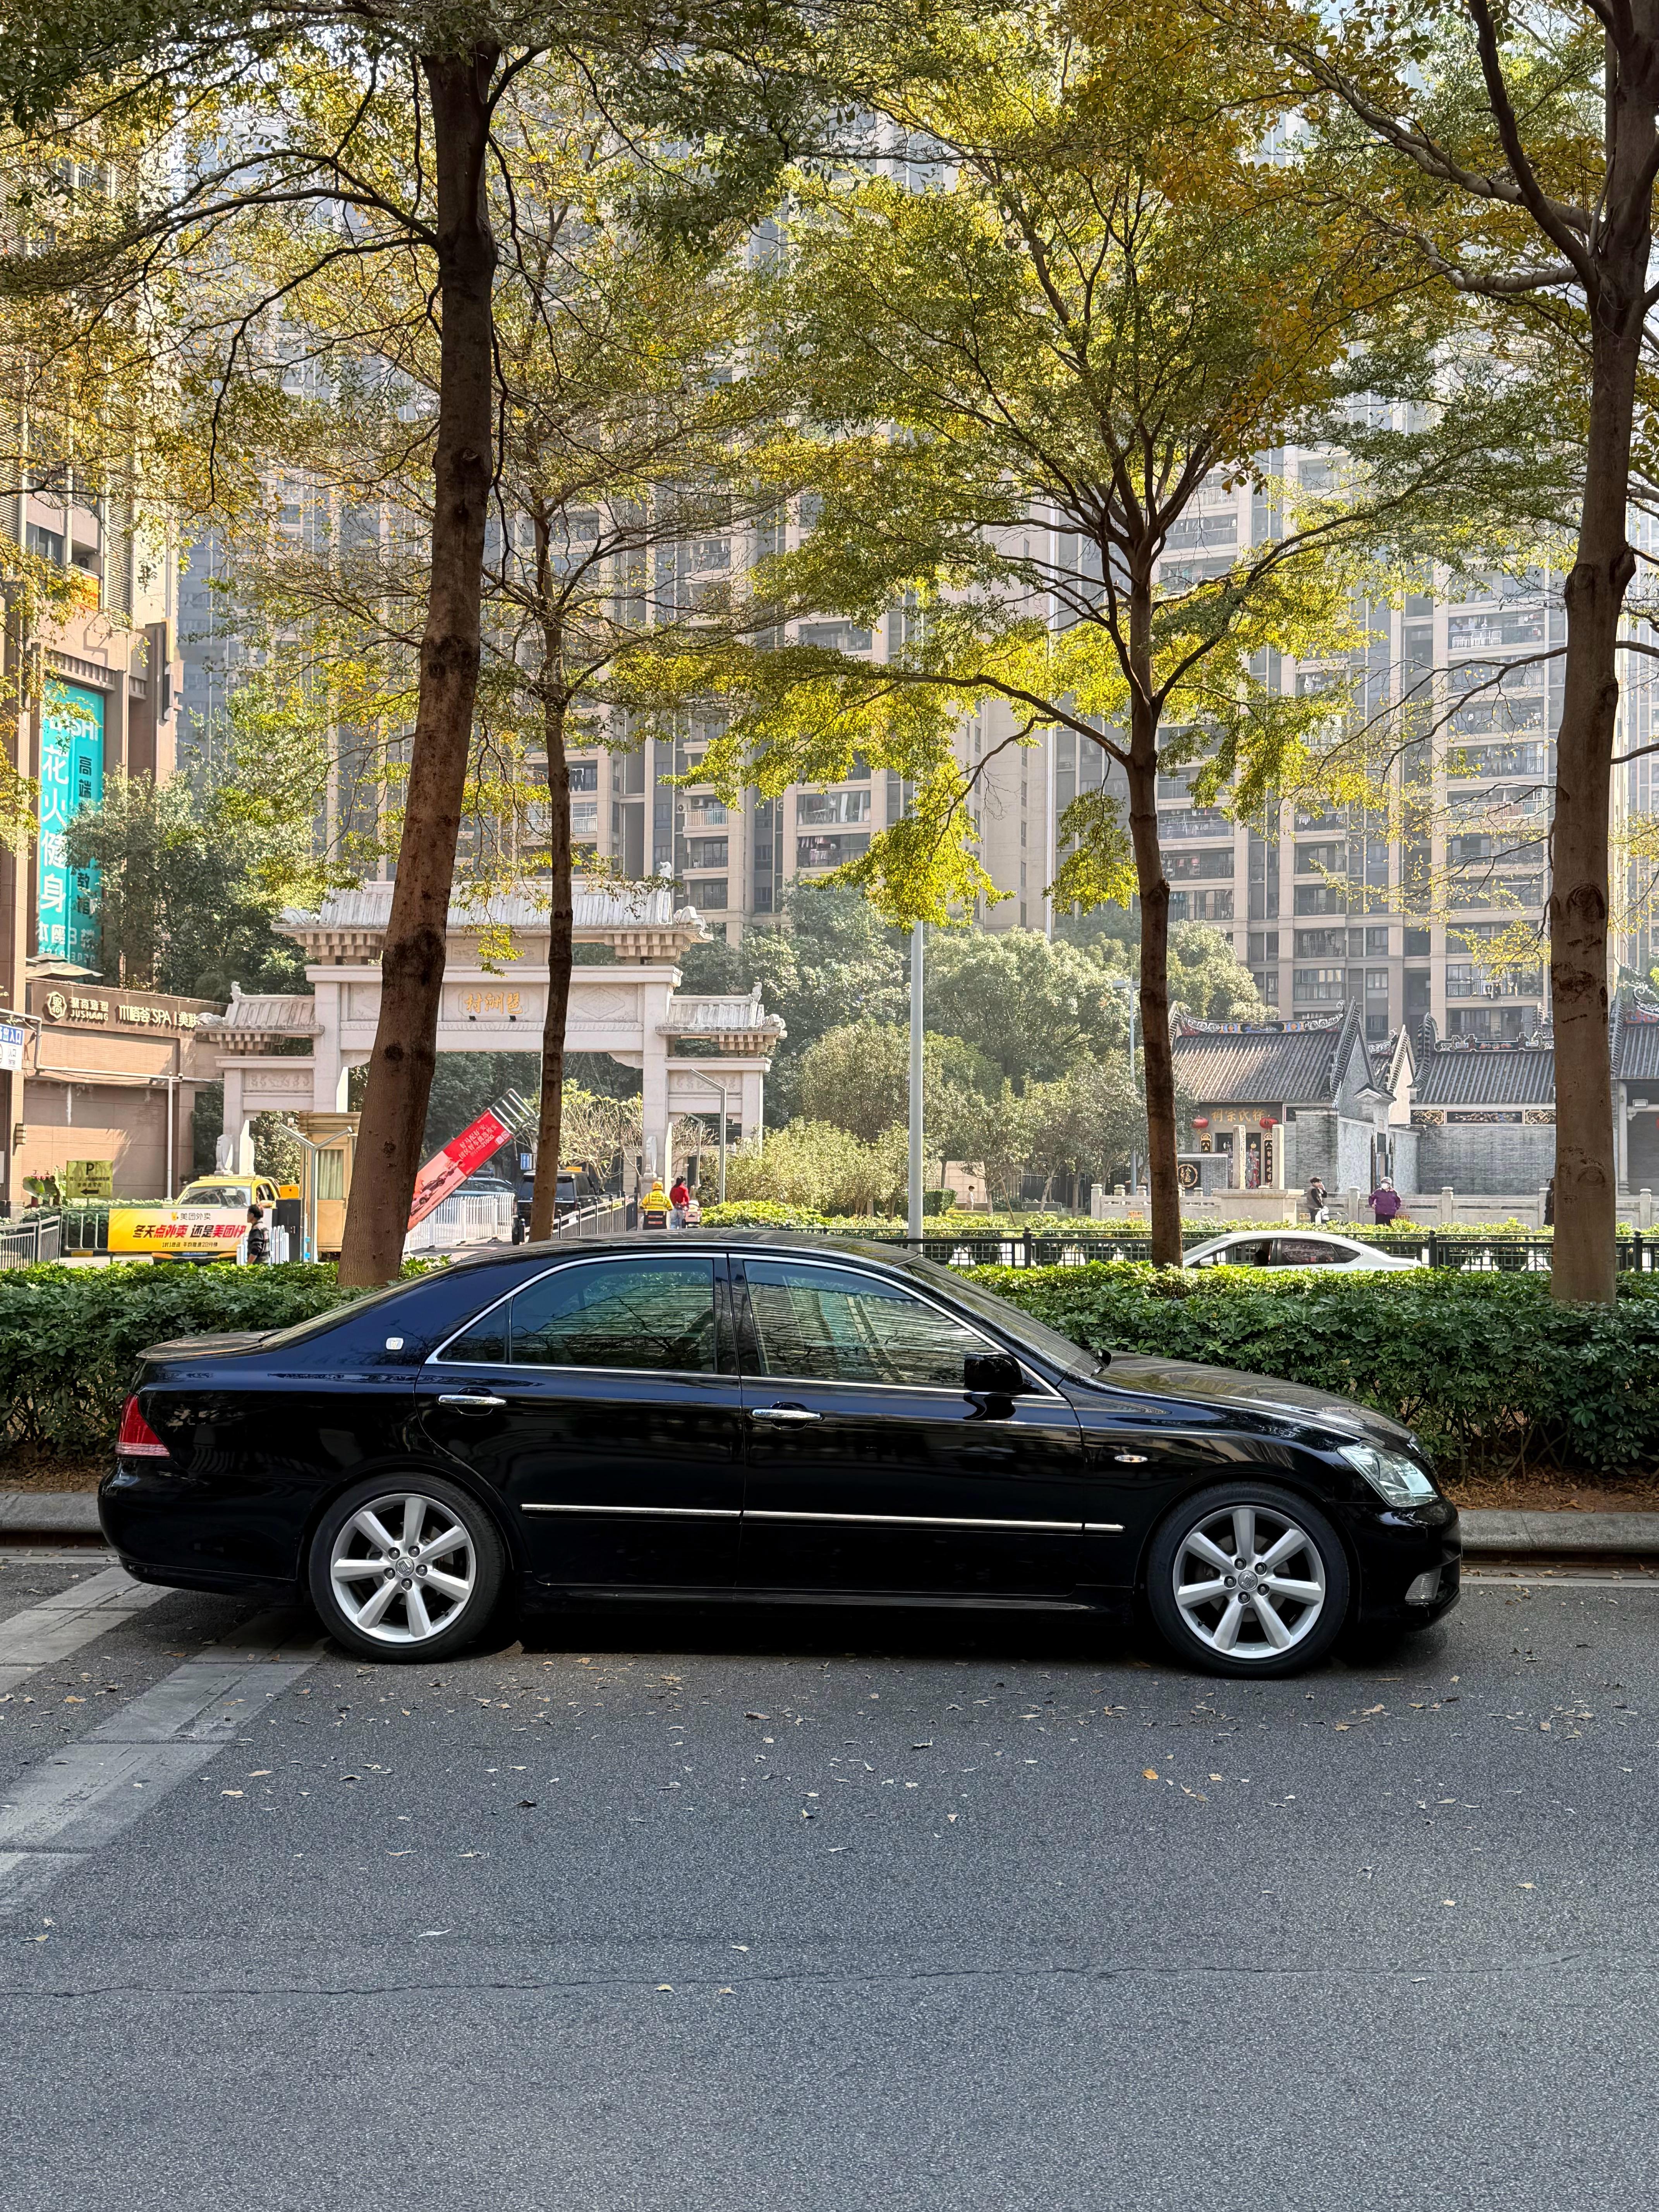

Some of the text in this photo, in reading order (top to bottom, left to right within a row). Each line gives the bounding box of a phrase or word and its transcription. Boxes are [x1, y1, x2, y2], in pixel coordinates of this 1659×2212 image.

[41, 744, 69, 913] 花火健身
[70, 1009, 108, 1021] JUSHANG
[86, 1163, 94, 1175] P
[180, 1212, 211, 1221] 美团外卖
[133, 1224, 189, 1238] 冬天点外卖
